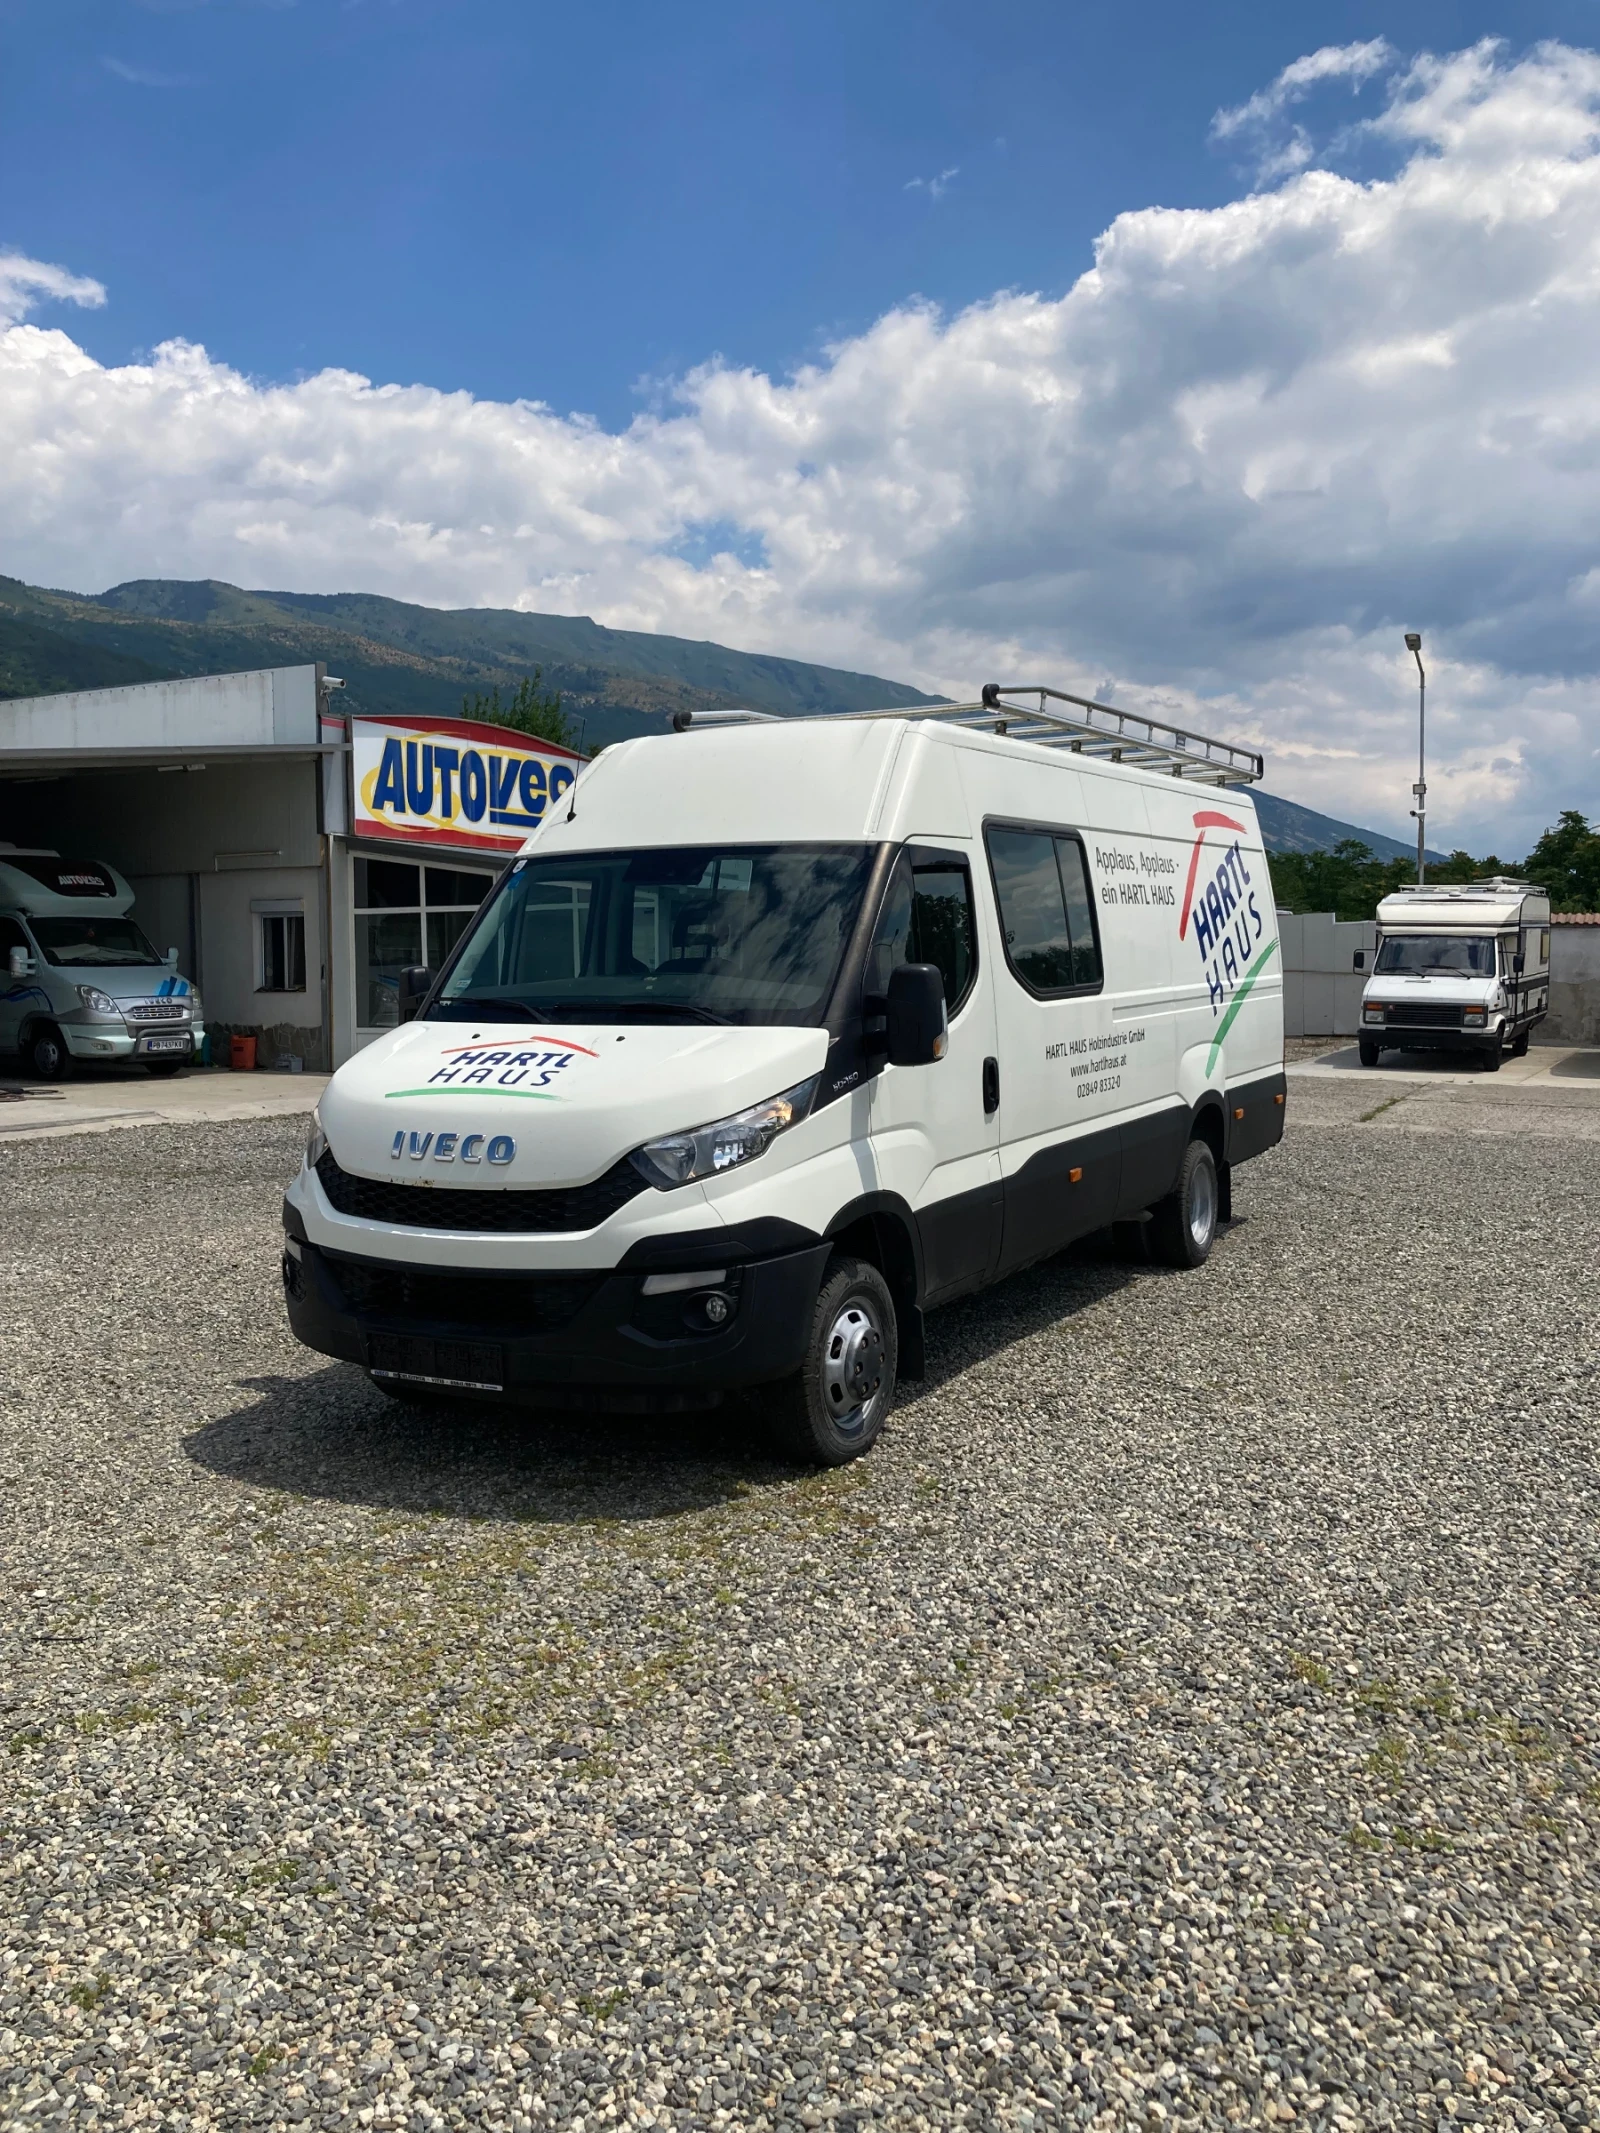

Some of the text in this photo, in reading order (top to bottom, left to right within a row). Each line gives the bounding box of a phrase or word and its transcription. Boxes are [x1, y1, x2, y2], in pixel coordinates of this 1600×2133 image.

[1096, 846, 1139, 875] Applaus,
[1140, 851, 1175, 877] Applaus
[1102, 882, 1175, 905] ein HARTL HAUS
[1192, 840, 1251, 963] HARTL
[1205, 891, 1262, 1017] HAUS
[1045, 1028, 1145, 1060] HARTL HAUS Holzindustrie GmbH
[449, 1051, 575, 1068] HARTL
[1070, 1054, 1127, 1077] www.hartlhaus.at
[427, 1068, 560, 1086] HAUS
[1077, 1075, 1120, 1098] 02849 8332-0
[391, 1130, 517, 1165] IVECO
